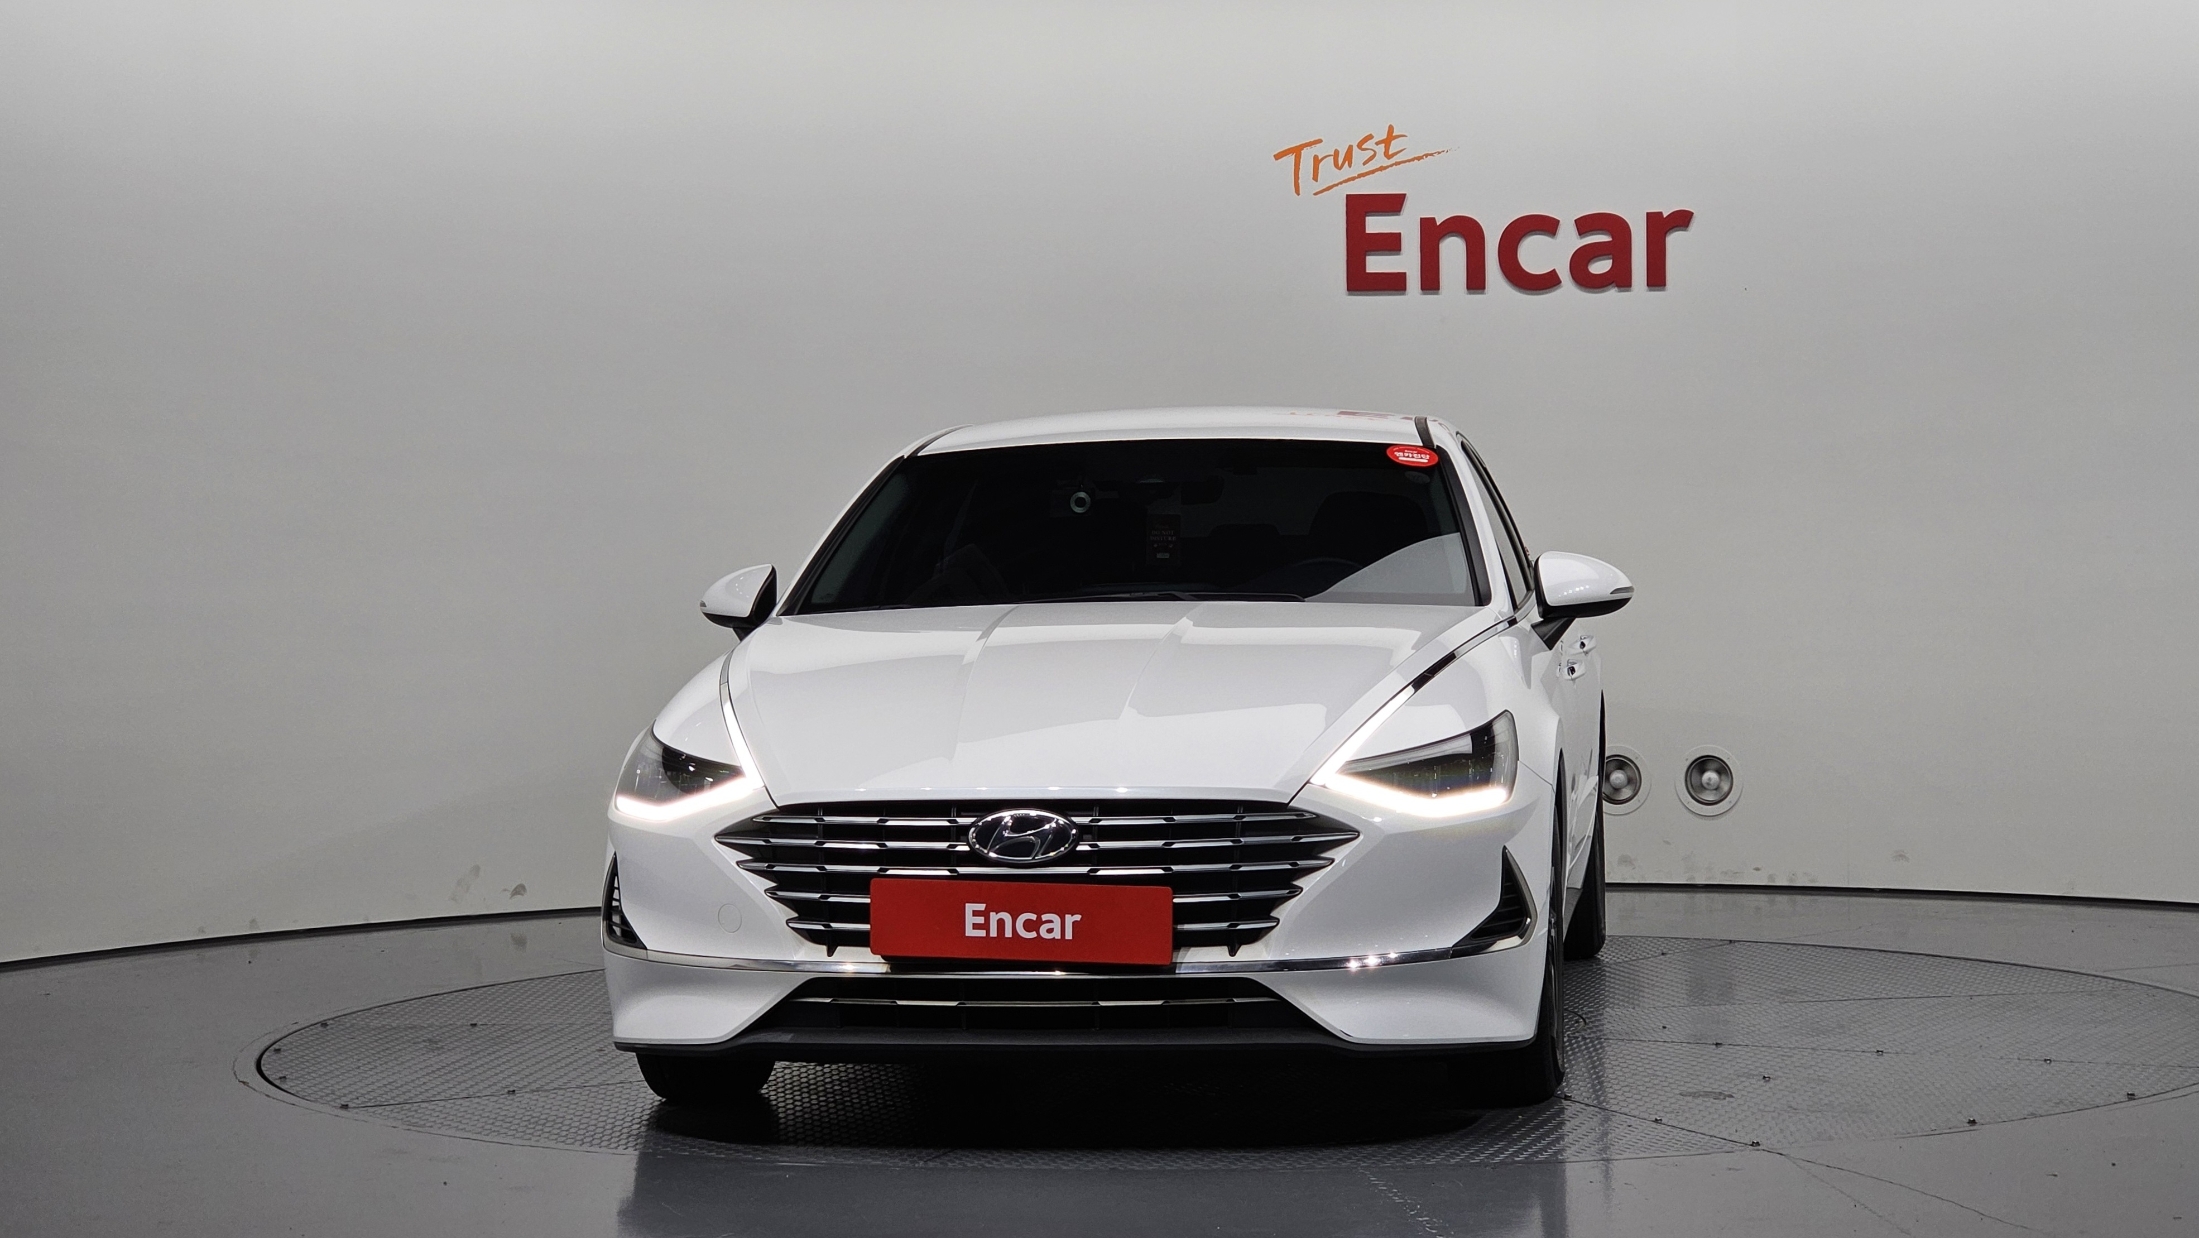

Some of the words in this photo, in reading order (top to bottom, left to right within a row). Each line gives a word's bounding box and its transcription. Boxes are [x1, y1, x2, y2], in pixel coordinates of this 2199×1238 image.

[1273, 124, 1408, 196] Trust
[1346, 193, 1694, 291] Encar
[965, 903, 1082, 940] Encar
